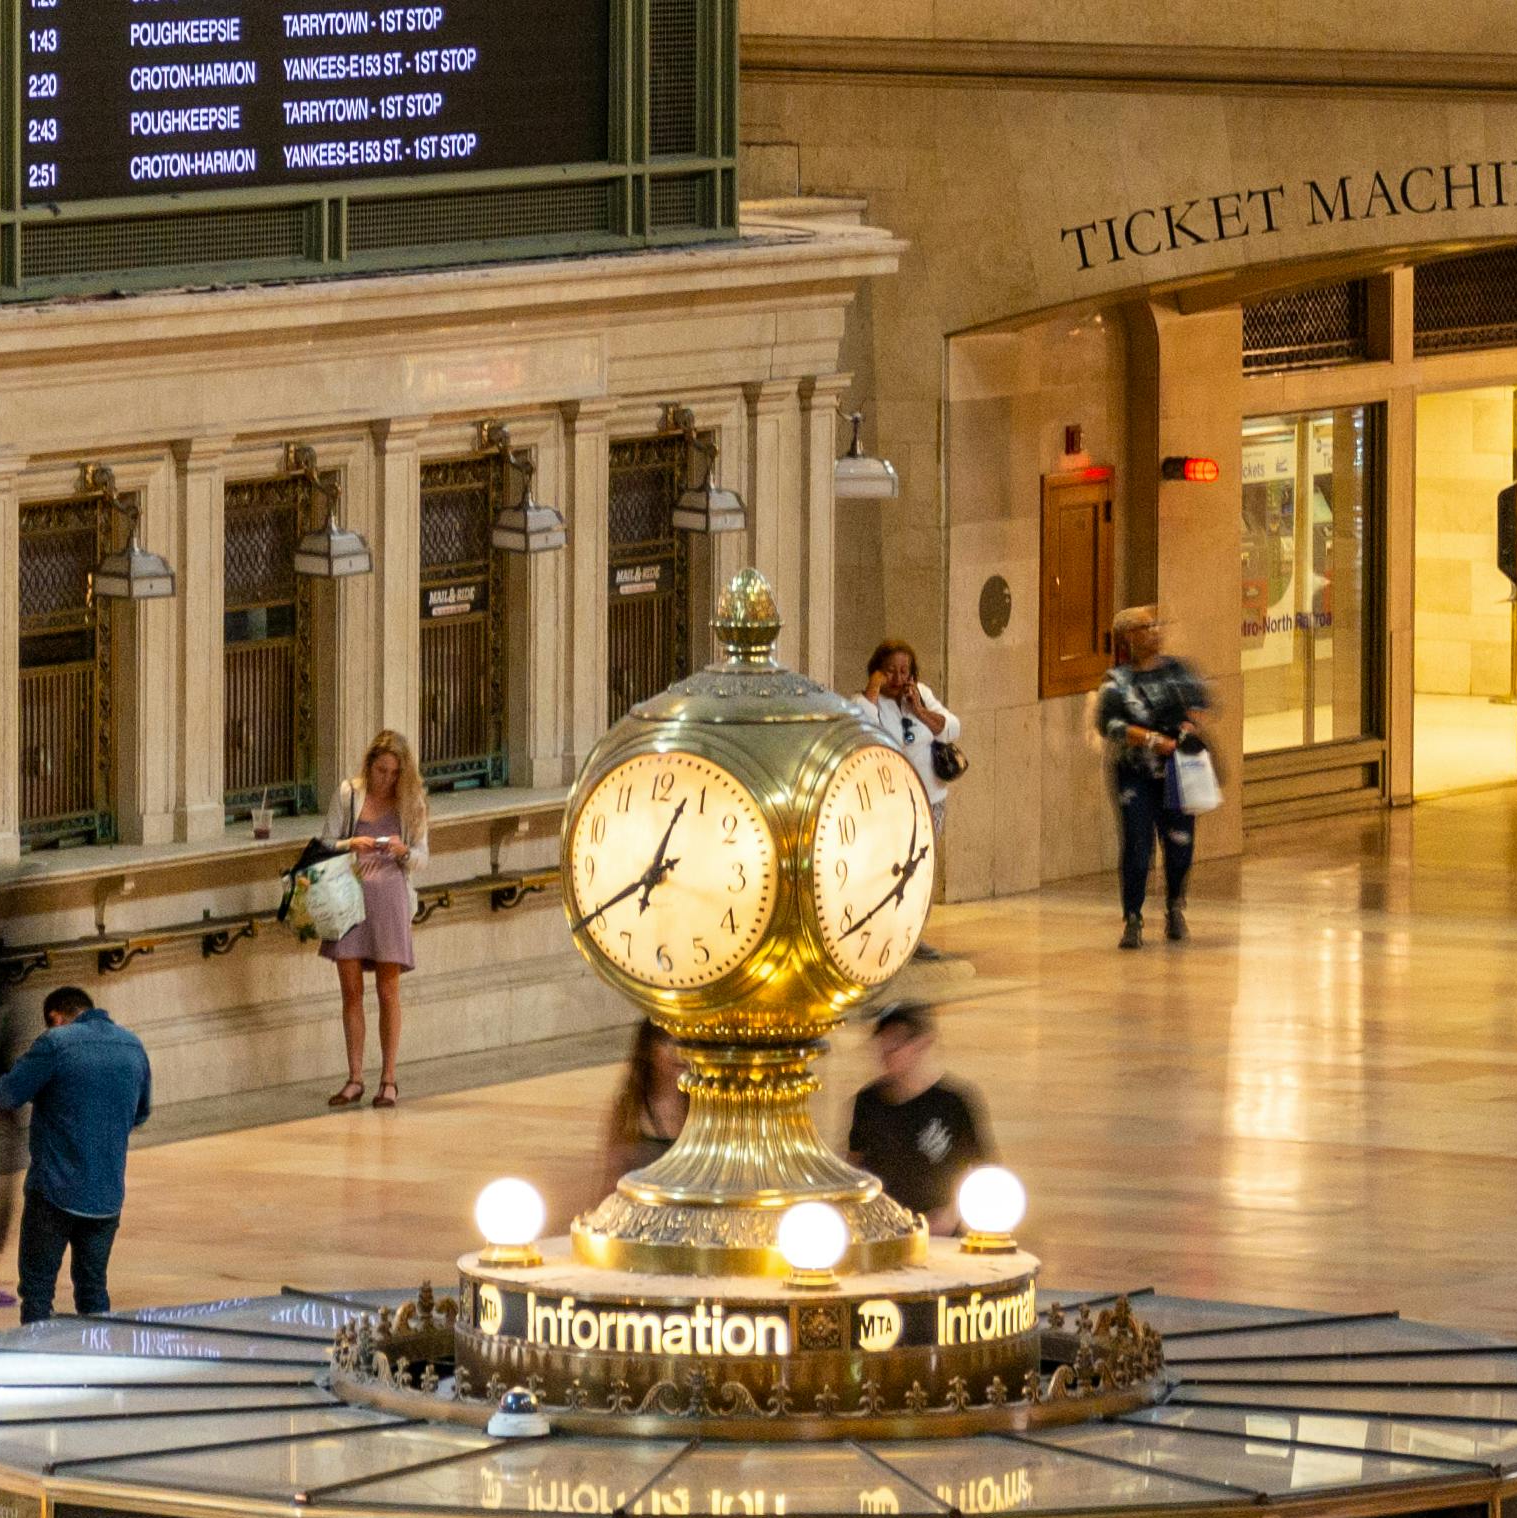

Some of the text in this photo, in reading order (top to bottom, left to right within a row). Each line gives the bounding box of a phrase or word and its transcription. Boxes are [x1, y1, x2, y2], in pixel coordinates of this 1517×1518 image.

[130, 17, 240, 47] POUGHKEEPSIE
[282, 6, 443, 38] TARRYTOWN 1ST STOP
[29, 28, 57, 53] 1:43
[130, 61, 256, 92] CROTON-HARMON
[283, 47, 477, 81] YANKEES-E153 ST. 1ST STOP
[28, 73, 58, 98] 2:20
[130, 105, 240, 136] POUGHKEEPSIE
[282, 92, 443, 125] TARRYTOWN 1ST STOP
[28, 118, 57, 143] 2:43
[130, 148, 256, 180] CROTON-HARMON
[283, 133, 477, 169] YANKEES-E153 ST. 1ST STOP
[28, 163, 56, 188] 2:51
[1061, 184, 1283, 271] TICKET
[527, 1291, 788, 1356] Information
